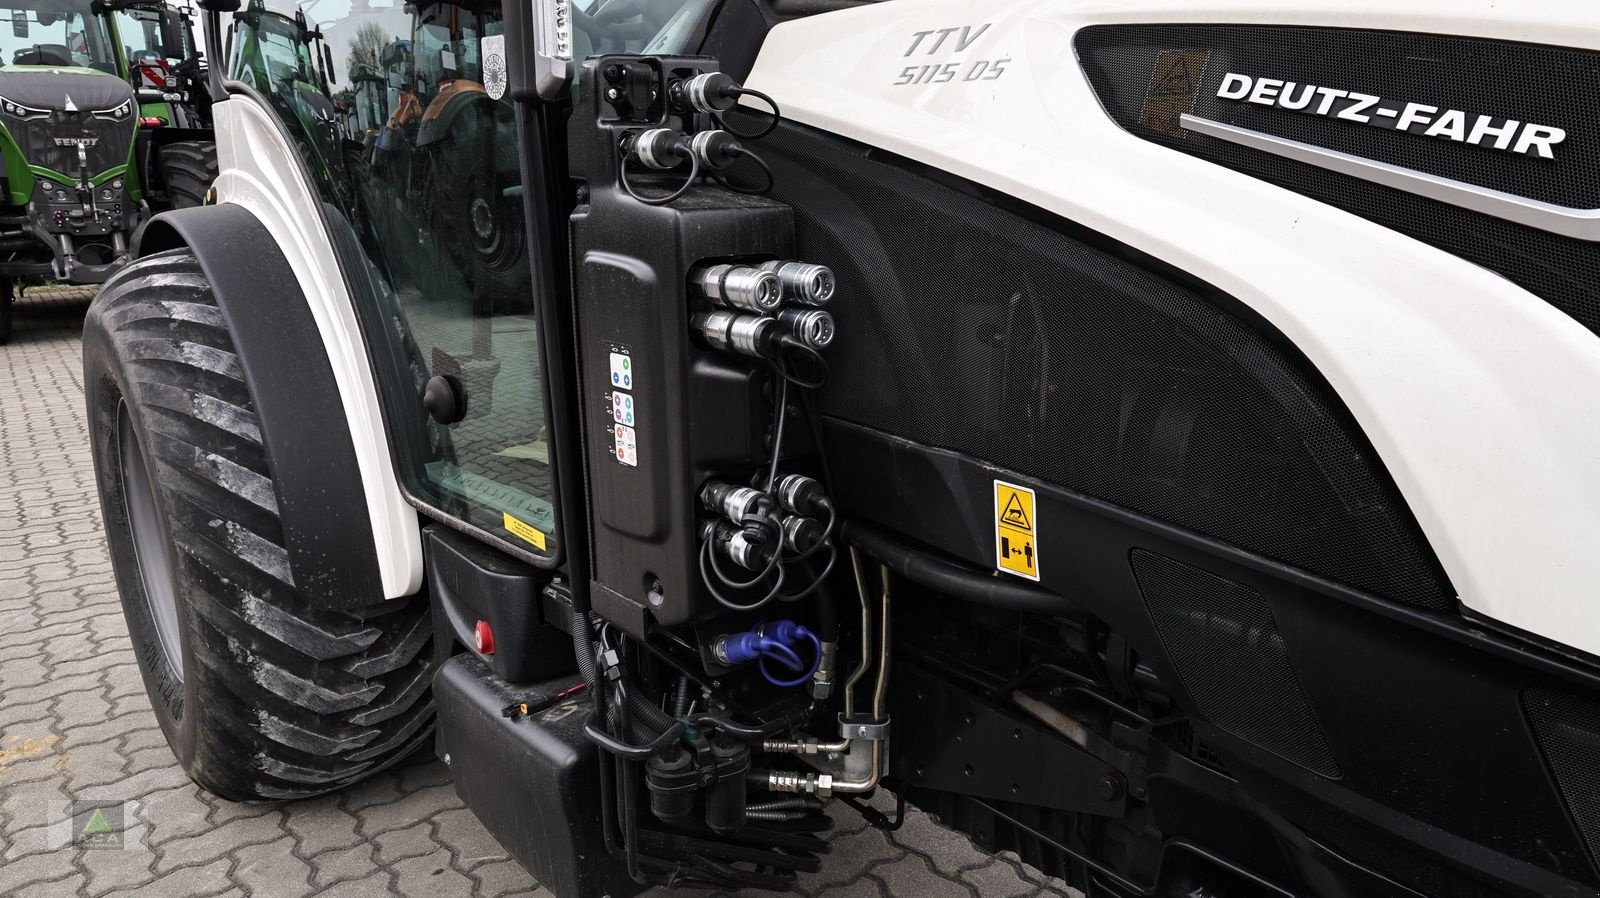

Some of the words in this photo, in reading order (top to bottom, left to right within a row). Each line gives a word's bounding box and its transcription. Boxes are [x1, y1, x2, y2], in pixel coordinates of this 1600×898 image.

[903, 23, 992, 57] TTV
[893, 63, 961, 85] 5115
[1216, 72, 1567, 160] DEUTZ-FAHR
[54, 137, 98, 146] FENDT
